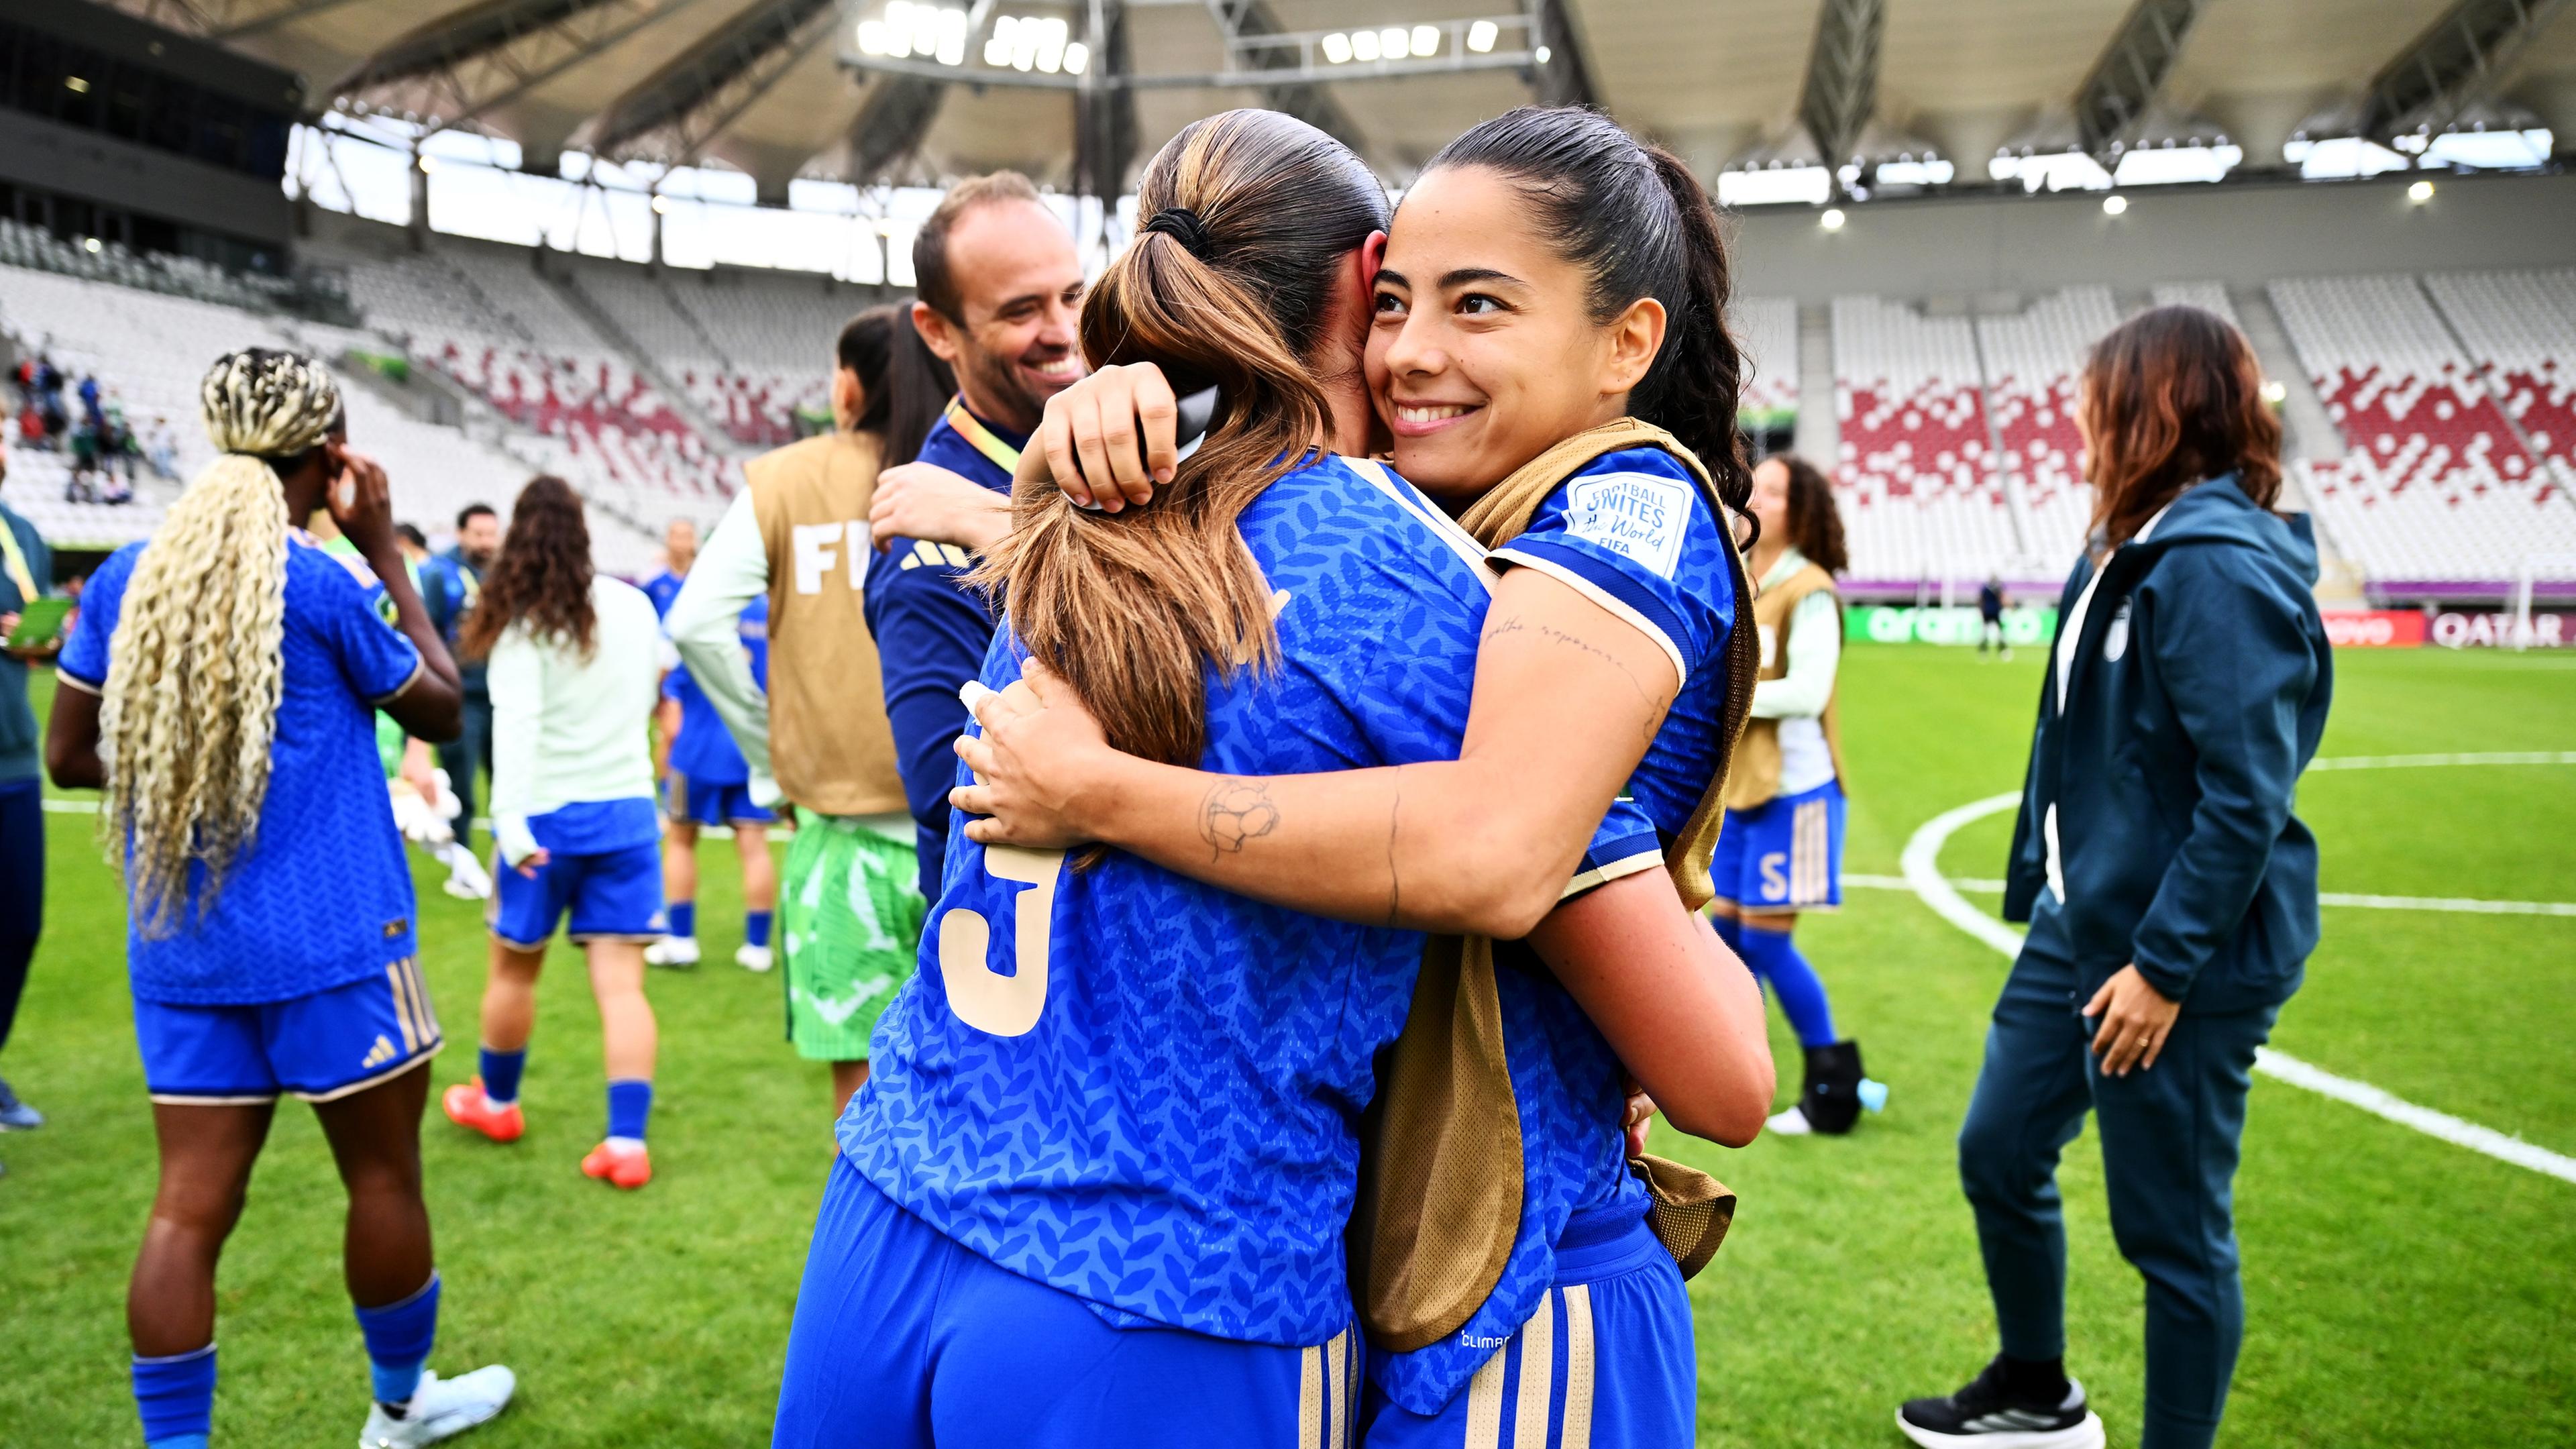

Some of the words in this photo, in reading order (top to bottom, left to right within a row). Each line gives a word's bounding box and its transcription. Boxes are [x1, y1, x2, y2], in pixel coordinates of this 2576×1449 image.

[1599, 537, 1629, 554] FIFA
[1611, 515, 1666, 552] World
[2432, 612, 2563, 649] QATAR
